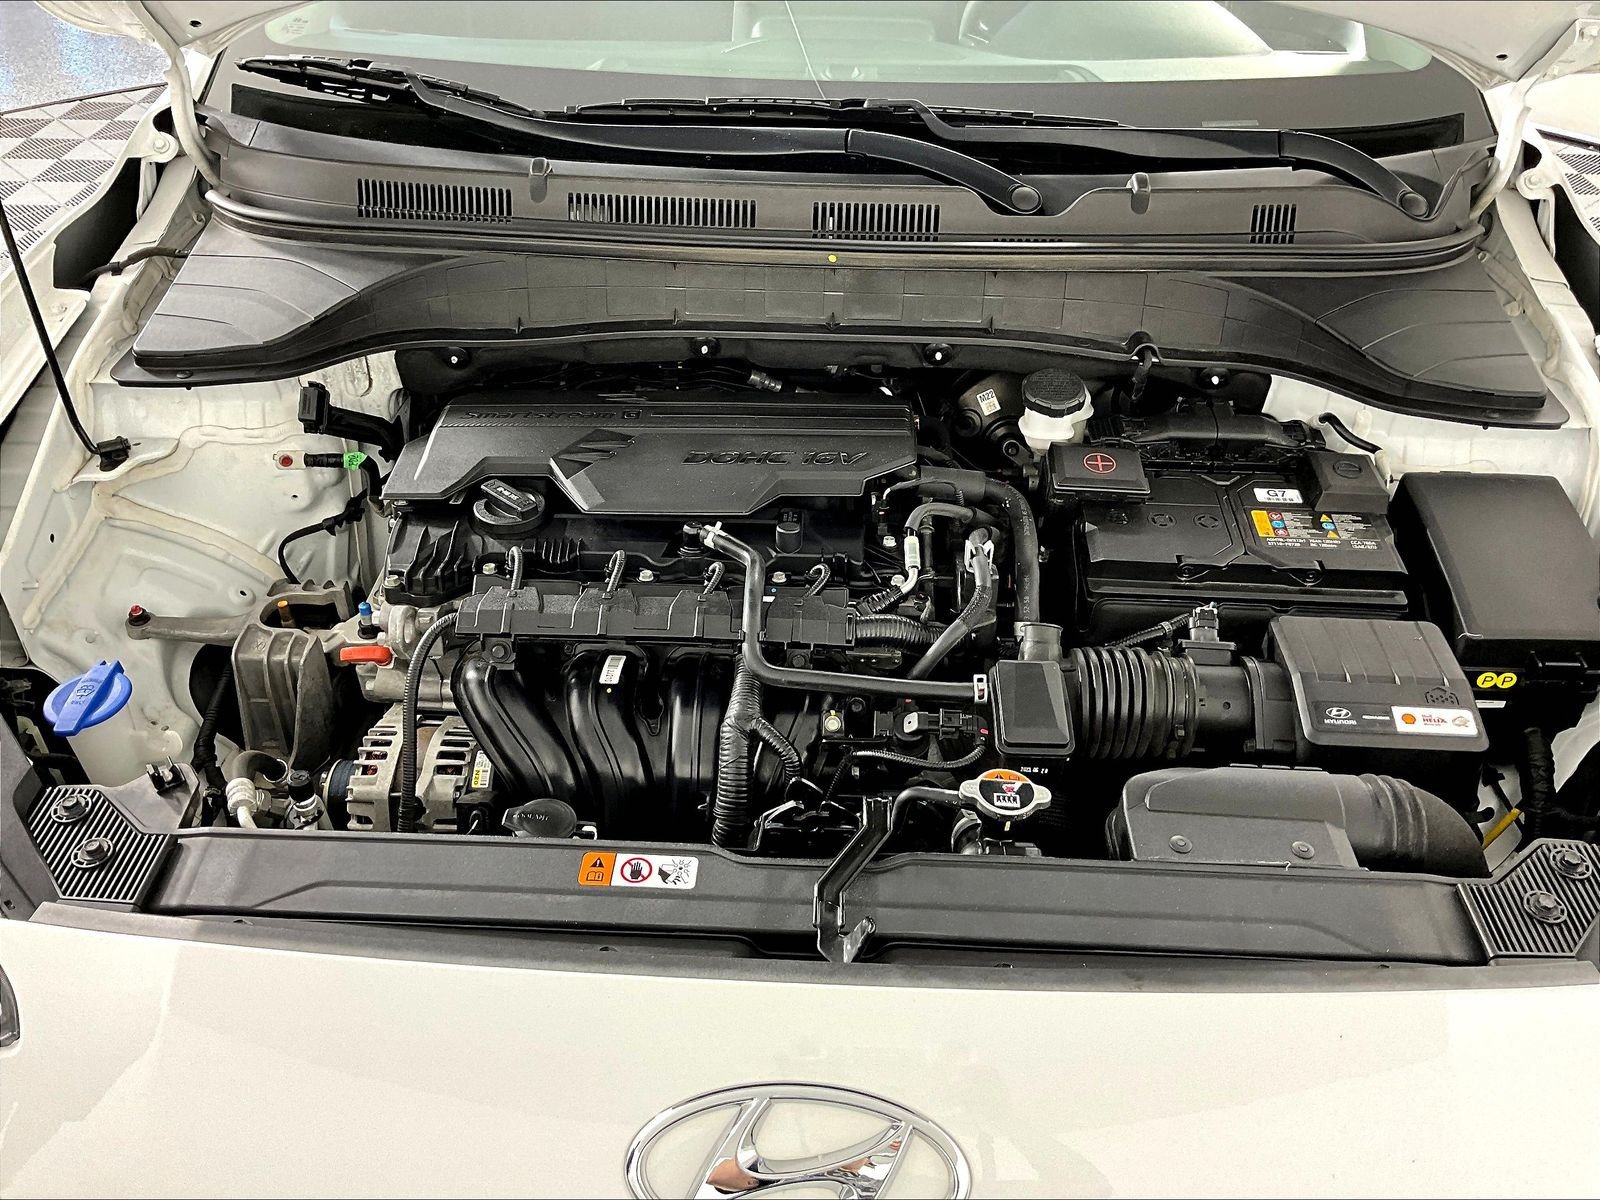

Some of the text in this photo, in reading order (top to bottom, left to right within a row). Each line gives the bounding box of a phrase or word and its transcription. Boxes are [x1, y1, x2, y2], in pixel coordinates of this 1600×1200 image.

[979, 389, 995, 403] M22
[463, 410, 617, 421] Smartstream
[681, 450, 868, 465] DOHC 16V
[1266, 489, 1287, 498] G7
[1323, 718, 1358, 726] HYUNDAI
[473, 769, 481, 786] N20
